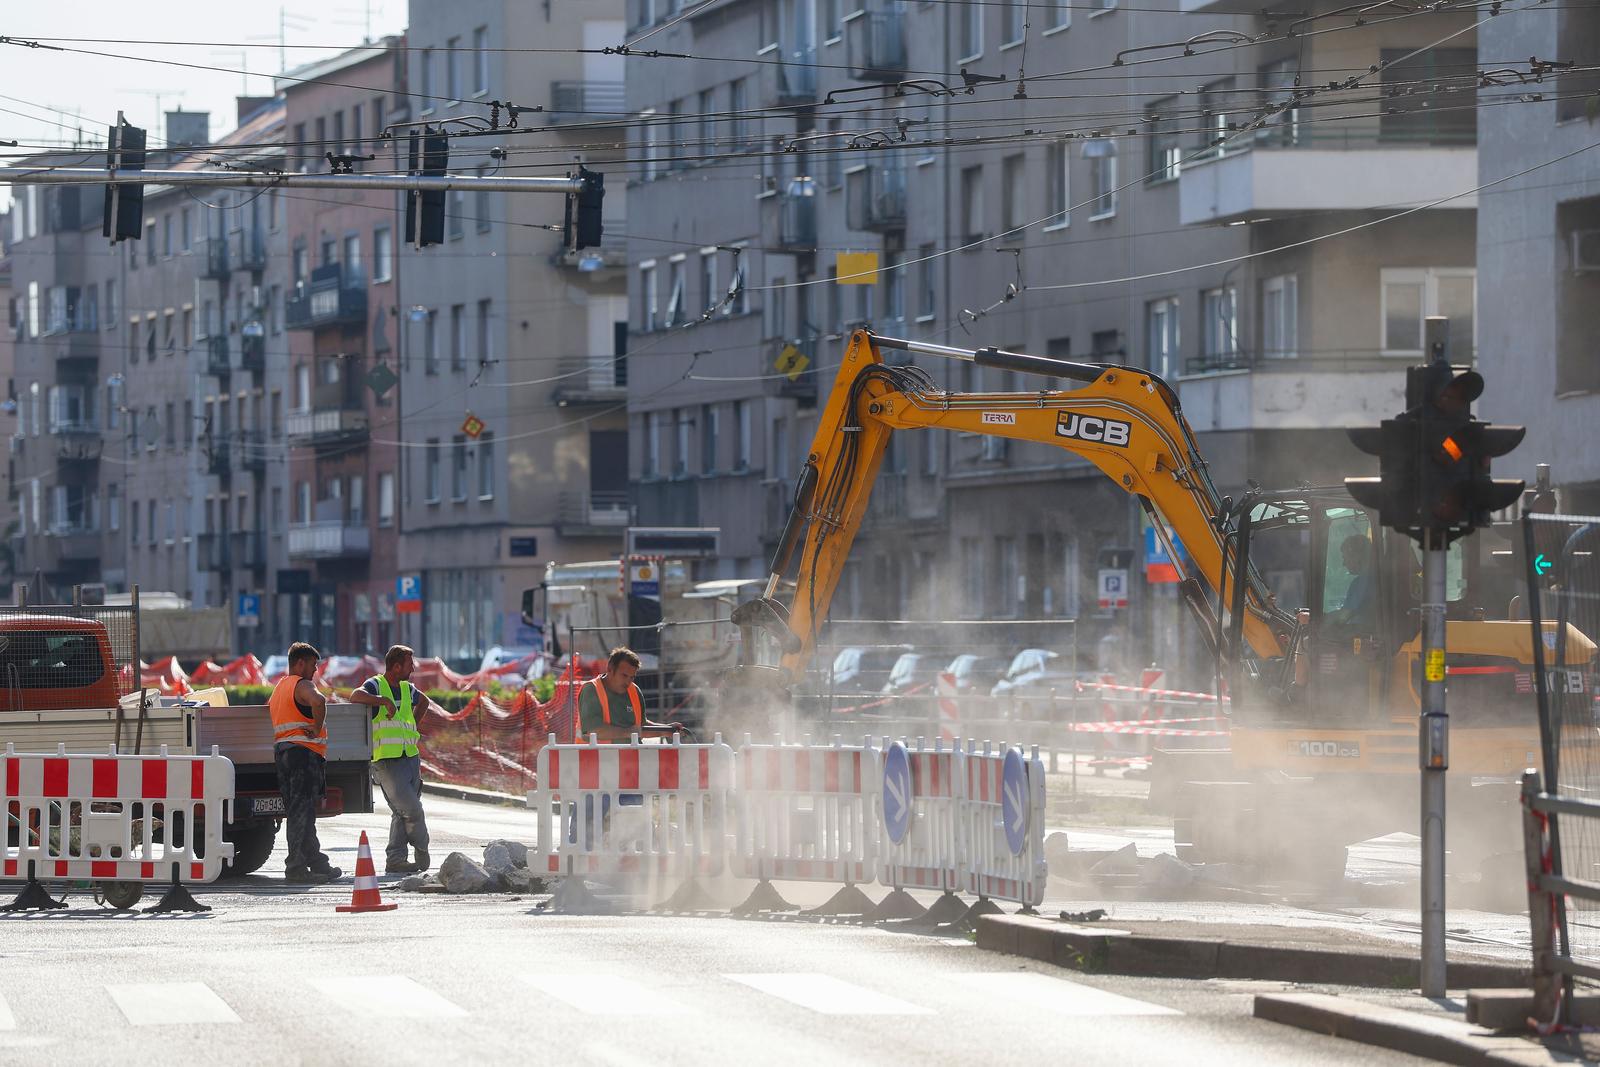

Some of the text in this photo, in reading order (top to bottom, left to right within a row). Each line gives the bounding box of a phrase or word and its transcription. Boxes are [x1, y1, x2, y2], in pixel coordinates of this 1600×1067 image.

[983, 413, 1013, 423] TERRA
[1057, 414, 1129, 446] JCB
[401, 577, 414, 596] P
[1108, 578, 1119, 592] P
[244, 598, 253, 613] P
